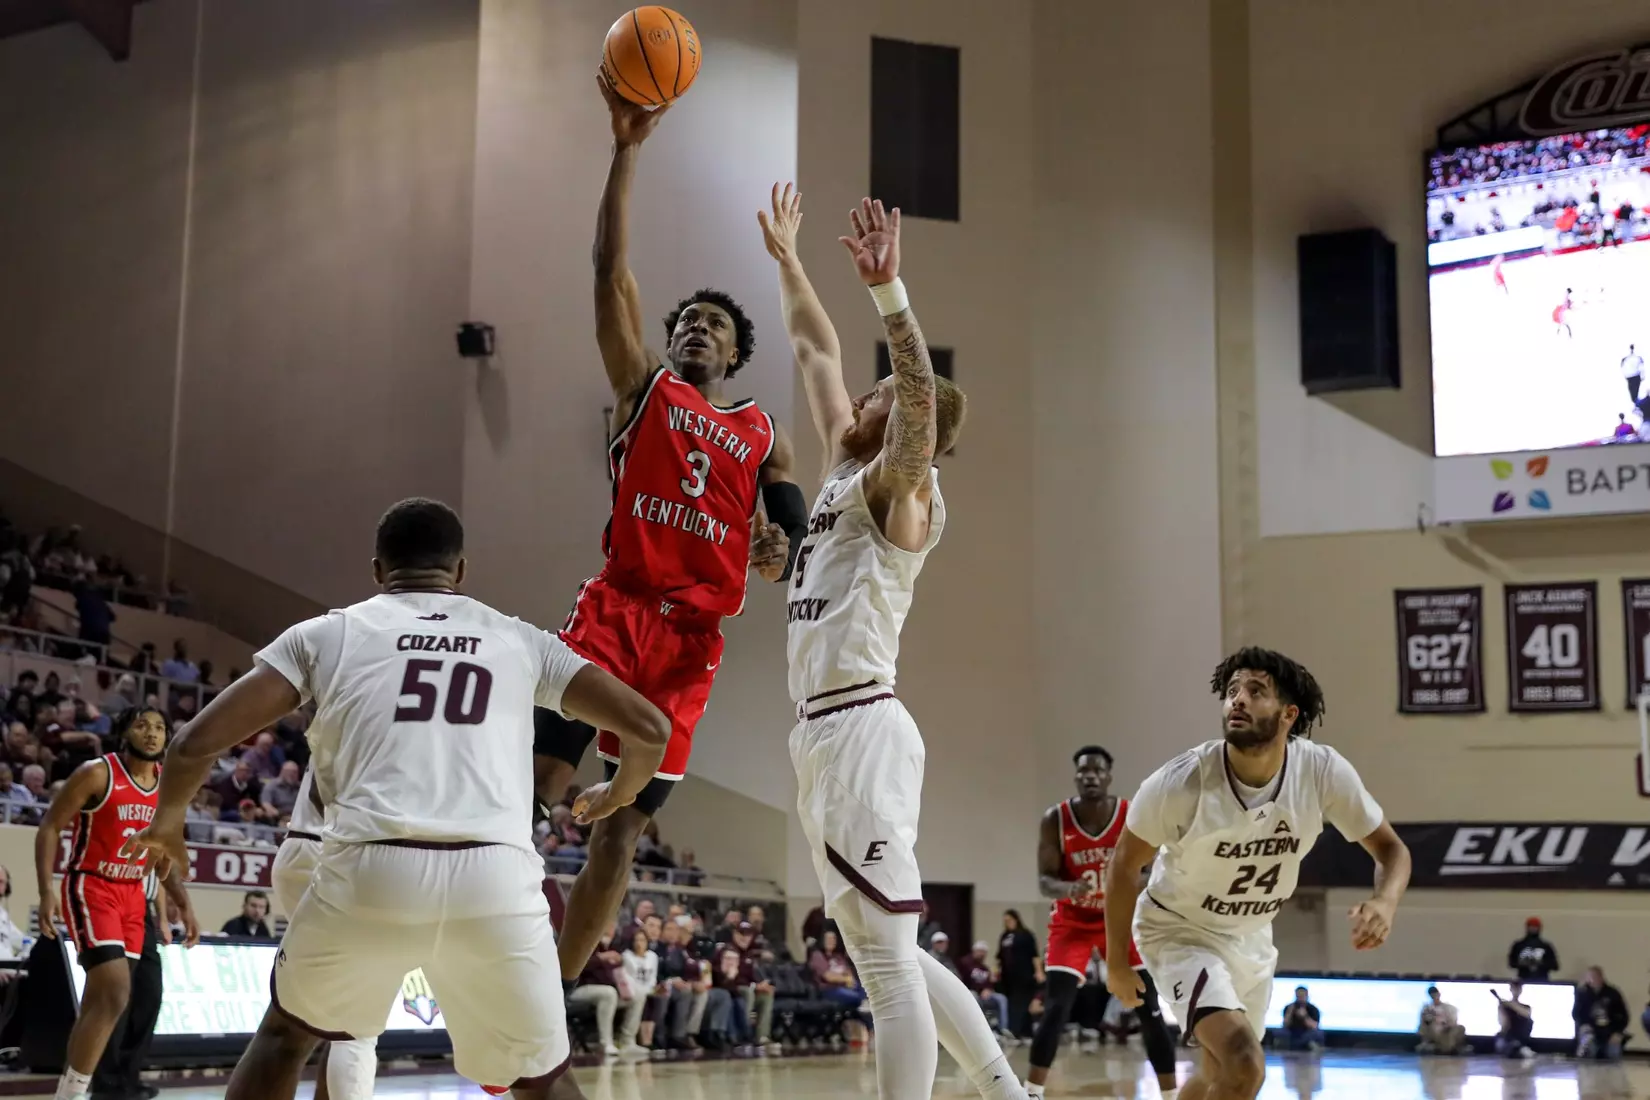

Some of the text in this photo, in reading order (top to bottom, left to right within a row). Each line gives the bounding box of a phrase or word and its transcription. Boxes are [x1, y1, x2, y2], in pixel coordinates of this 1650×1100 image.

[668, 405, 751, 463] WESTERN
[680, 449, 711, 498] 3
[632, 492, 730, 546] KENTUCKY
[397, 633, 482, 656] COZART
[1407, 634, 1472, 670] 627
[1521, 623, 1580, 668] 40
[393, 657, 494, 726] 50
[1213, 836, 1301, 859] EASTERN
[1443, 826, 1589, 865] EKU
[215, 851, 268, 884] OF
[1227, 863, 1282, 895] 24
